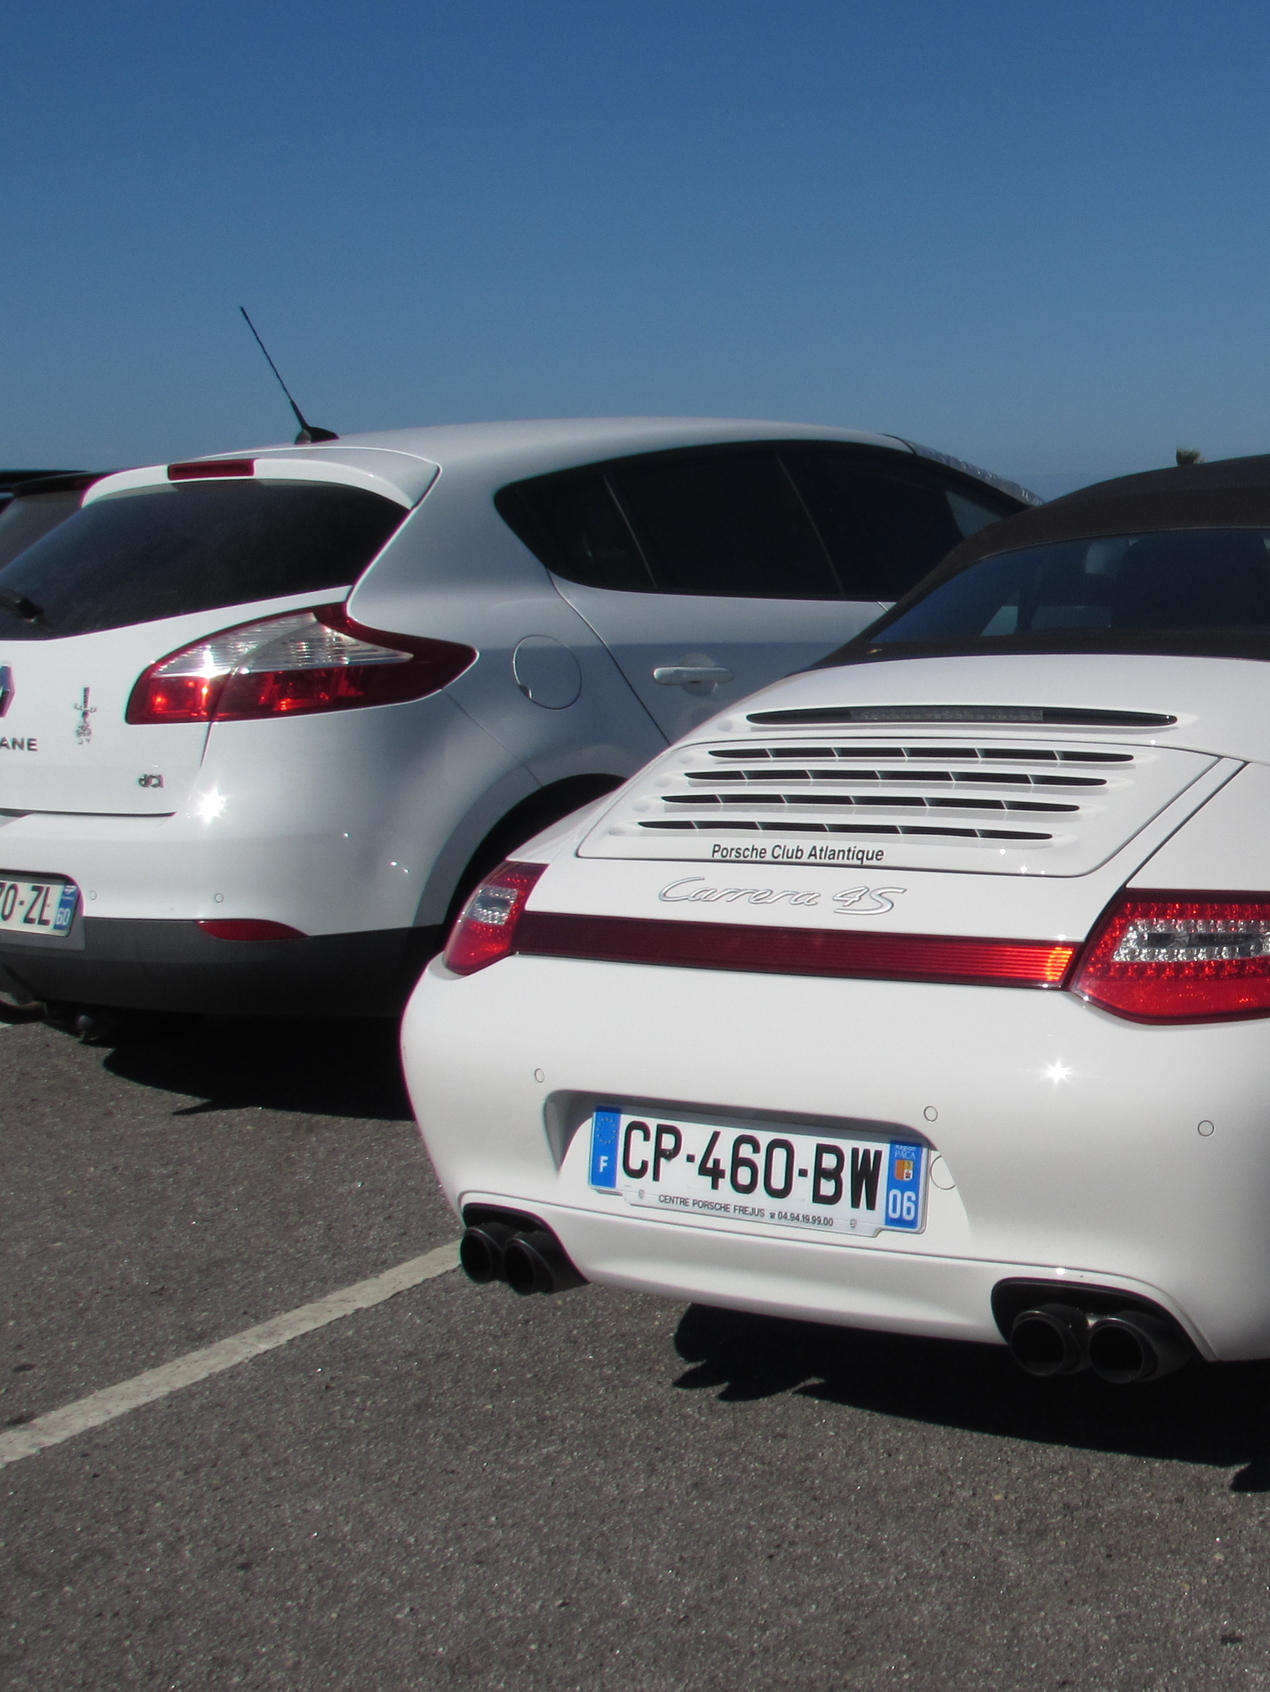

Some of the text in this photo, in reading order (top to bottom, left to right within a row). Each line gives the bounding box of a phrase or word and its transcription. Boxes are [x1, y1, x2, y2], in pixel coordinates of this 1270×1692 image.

[0, 737, 38, 751] ANE
[711, 843, 884, 865] Porsche Club Atlantique
[658, 876, 907, 915] Carrera 4S
[600, 1155, 609, 1173] F
[622, 1120, 883, 1212] CP-460-BW
[894, 1150, 916, 1160] PACA
[658, 1194, 834, 1227] CENTRE PORSCHE FREJUS 04.94.19.99.00
[888, 1188, 916, 1221] 06
